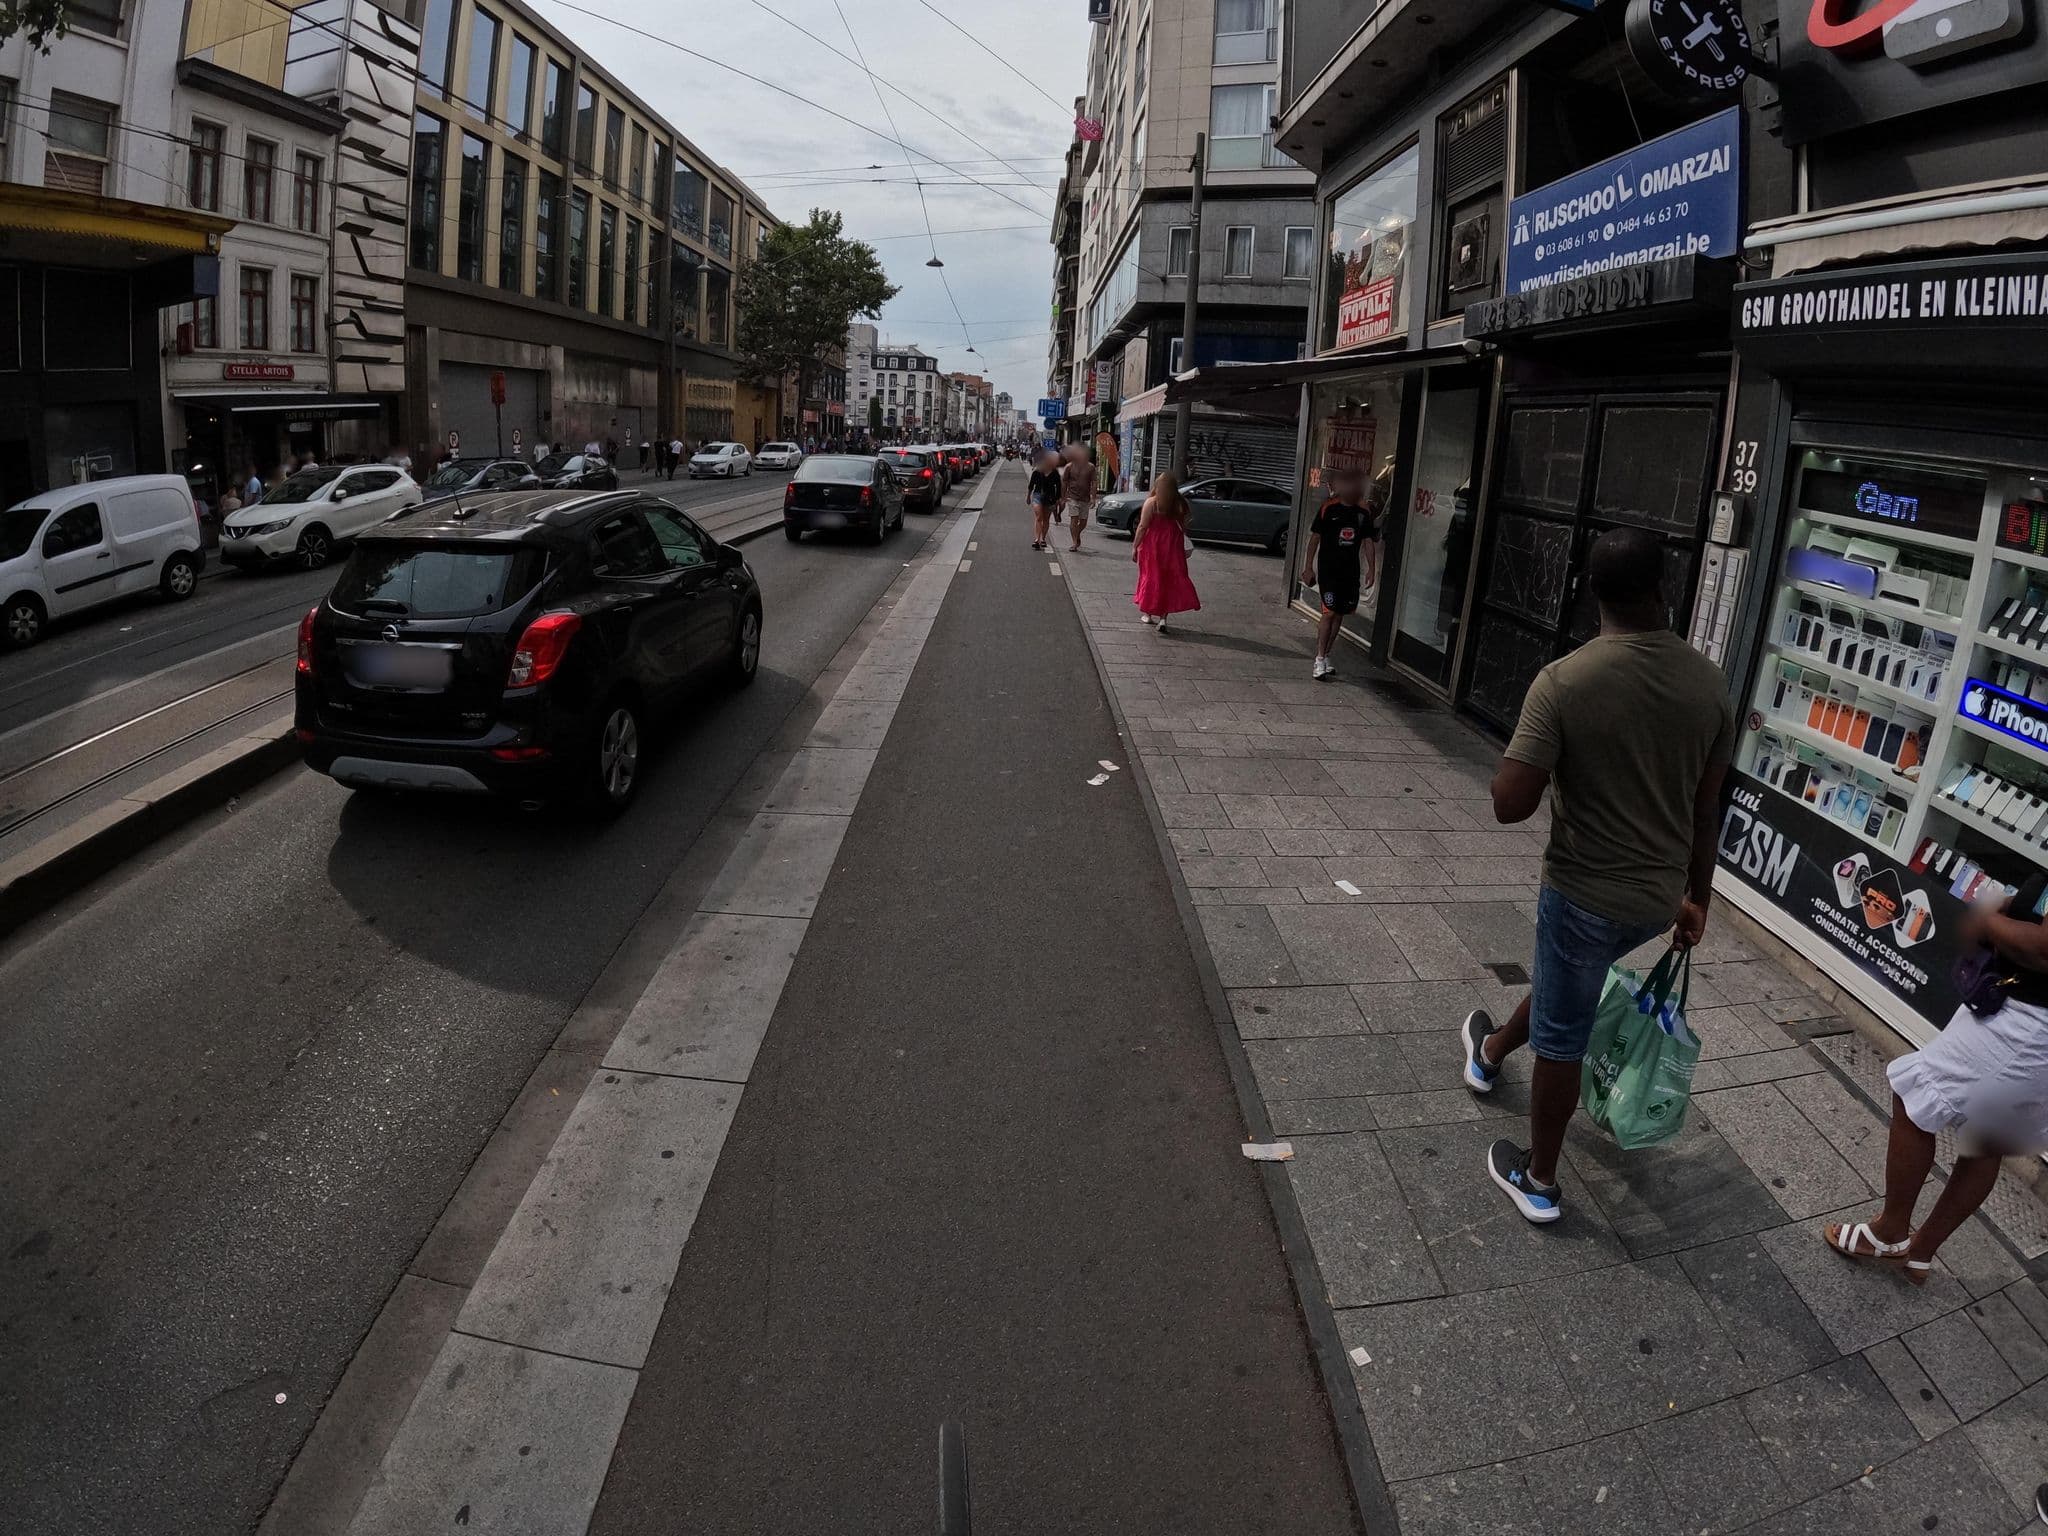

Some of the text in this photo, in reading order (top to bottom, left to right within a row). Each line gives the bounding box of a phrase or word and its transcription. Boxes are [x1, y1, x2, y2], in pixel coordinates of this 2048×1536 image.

[1658, 36, 1745, 90] EXPRESS
[1535, 146, 1730, 235] RIJSCHOOL OMARZAI
[1546, 202, 1689, 256] 03 608 61 90 0484 46 63 70
[1344, 290, 1391, 324] TOTALE
[1742, 295, 1776, 329] GSM
[1780, 282, 1911, 326] GROOTHANDEL
[1919, 280, 1947, 318] EN
[1342, 317, 1389, 345] UITVERKOOP
[232, 366, 290, 376] STELLA ARTOIS
[1736, 440, 1759, 468] 37
[1732, 470, 1757, 494] 39
[1988, 699, 2048, 745] iPhon
[1732, 786, 1764, 813] uni
[1718, 804, 1801, 897] GSM
[1814, 897, 1929, 985] REPARATIE ACCESSORIES
[1815, 915, 1870, 959] ONDERDELEN
